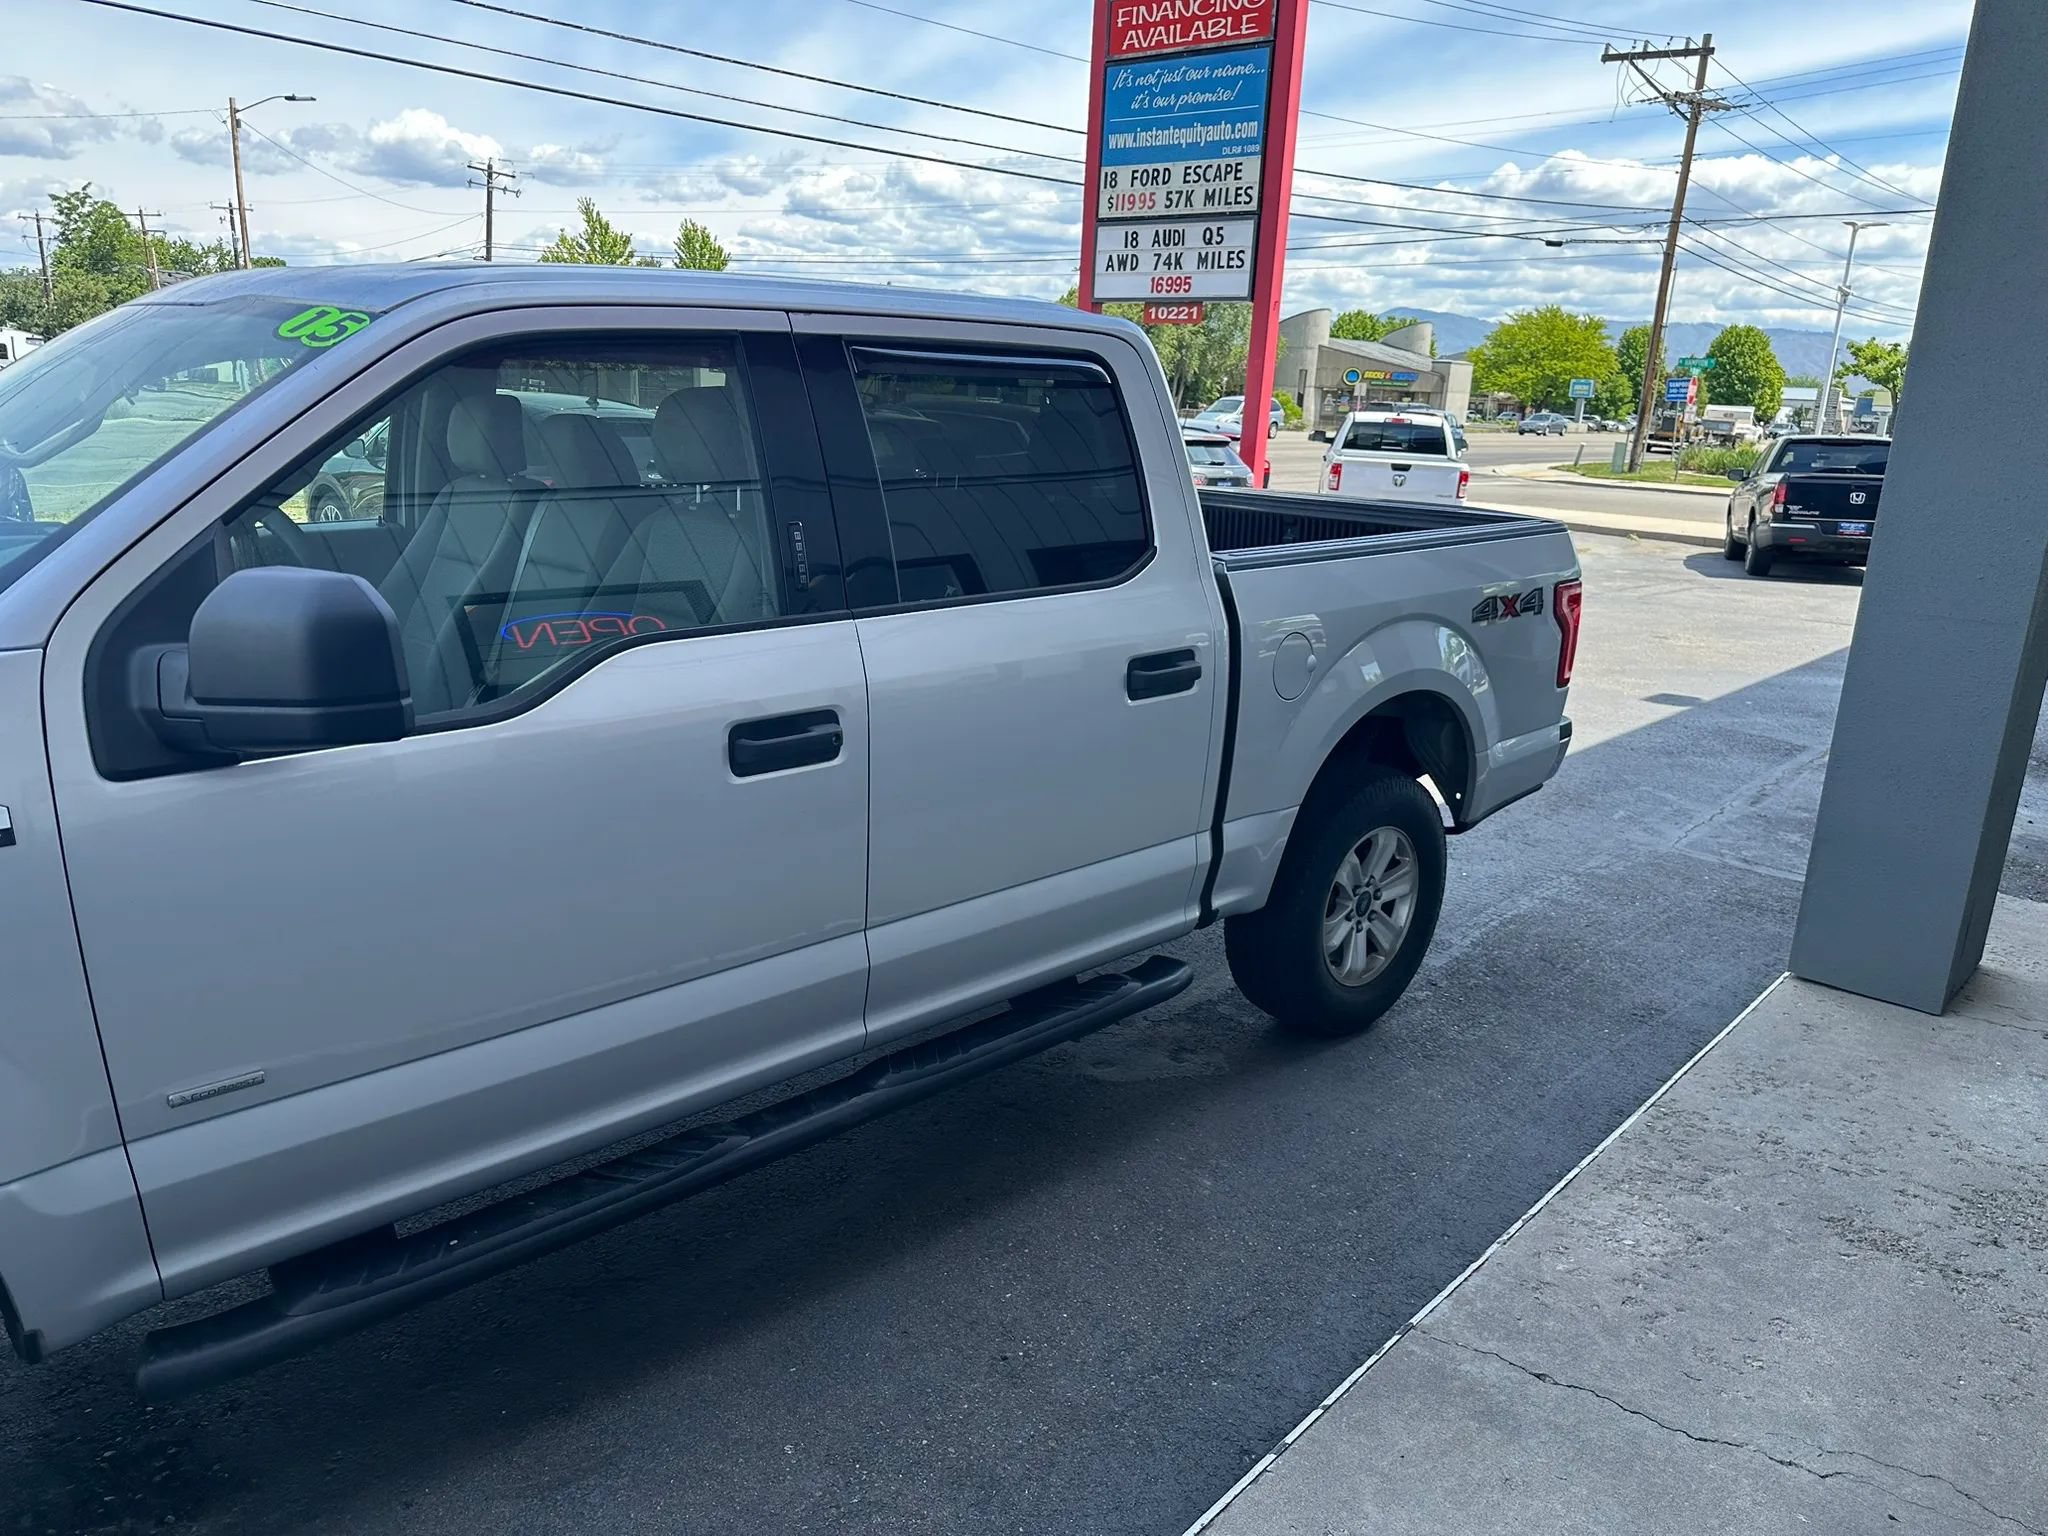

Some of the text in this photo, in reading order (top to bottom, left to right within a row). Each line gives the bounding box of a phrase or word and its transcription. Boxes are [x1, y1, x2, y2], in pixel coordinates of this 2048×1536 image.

[1122, 13, 1259, 50] AVAILABLE
[1113, 63, 1264, 92] It's not just our name...
[1131, 80, 1242, 112] it's our promise!
[1108, 120, 1258, 149] www.instantequityauto.com
[1103, 162, 1243, 189] 18 FORD ESCAPE
[1107, 186, 1253, 212] $11995 57K MILES
[1124, 227, 1225, 248] 18 AUDI Q5
[1105, 250, 1245, 272] AWD 74K MILES
[1150, 276, 1192, 294] 16995
[1148, 306, 1199, 320] 10221
